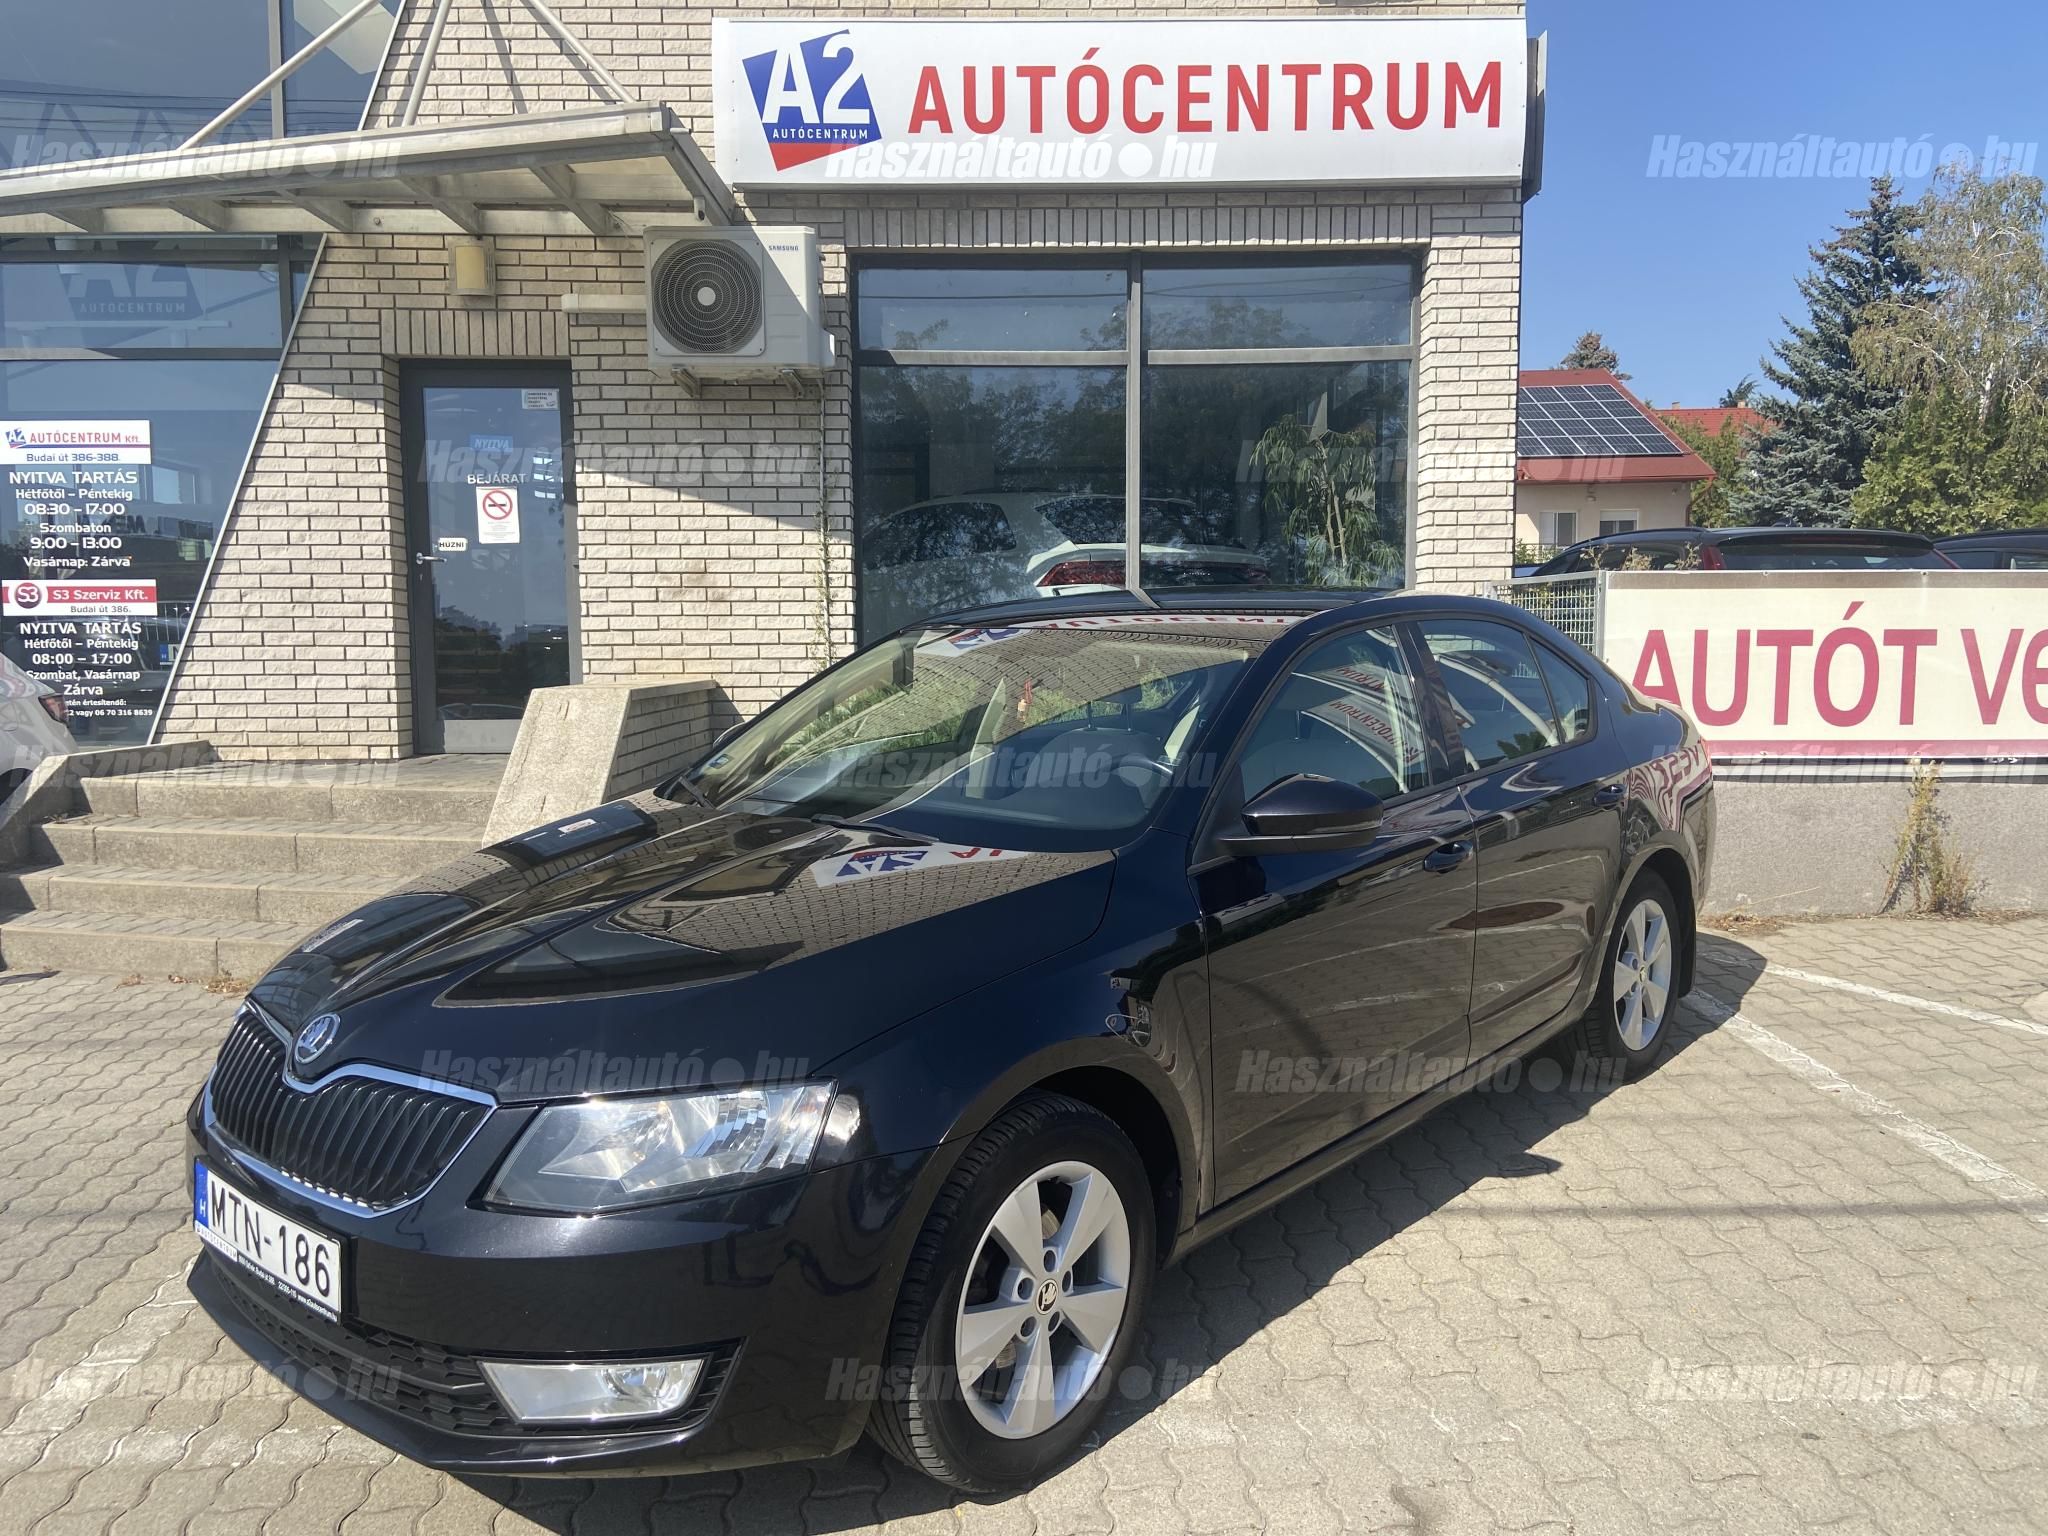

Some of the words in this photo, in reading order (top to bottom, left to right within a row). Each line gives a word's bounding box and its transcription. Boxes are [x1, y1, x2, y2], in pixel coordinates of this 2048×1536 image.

[762, 33, 870, 124] A2
[908, 47, 1502, 134] AUTÓCENTRUM
[773, 126, 868, 139] AUTÓCENTRUM
[30, 430, 121, 443] AUTÓCENTRUM
[26, 453, 56, 462] Budai
[58, 452, 69, 462] út
[71, 453, 120, 462] 386-388.
[9, 472, 67, 485] NYITVA
[72, 468, 138, 484] TARTÁS
[467, 472, 526, 484] BEJÁRAT
[16, 488, 65, 499] Hétfőtől
[78, 488, 133, 501] Péntekig
[24, 503, 70, 515] 08:30
[85, 503, 125, 515] 17:00
[40, 522, 112, 533] Szombaton
[31, 537, 67, 549] 9:00
[82, 537, 122, 549] 13:00
[24, 556, 88, 568] Vasárnap:
[91, 556, 131, 567] Zárva
[17, 586, 39, 603] S3
[53, 590, 70, 600] S3
[73, 589, 121, 600] Szerviz
[125, 589, 148, 600] Kft.
[70, 605, 97, 613] Budai
[99, 604, 108, 613] út
[111, 605, 131, 613] 386.
[20, 622, 77, 635] NYITVA
[83, 618, 142, 635] TARTÁS
[24, 638, 72, 649] Hétfőtől
[87, 638, 139, 651] Péntekig
[32, 653, 73, 665] 08:00
[91, 653, 132, 665] 17:00
[1632, 601, 1938, 727] AUTÓT
[26, 669, 81, 682] Szombat,
[84, 669, 141, 682] Vasárnap
[63, 683, 104, 696] Zárva
[107, 708, 117, 716] 70
[211, 1180, 331, 1298] MTN-186
